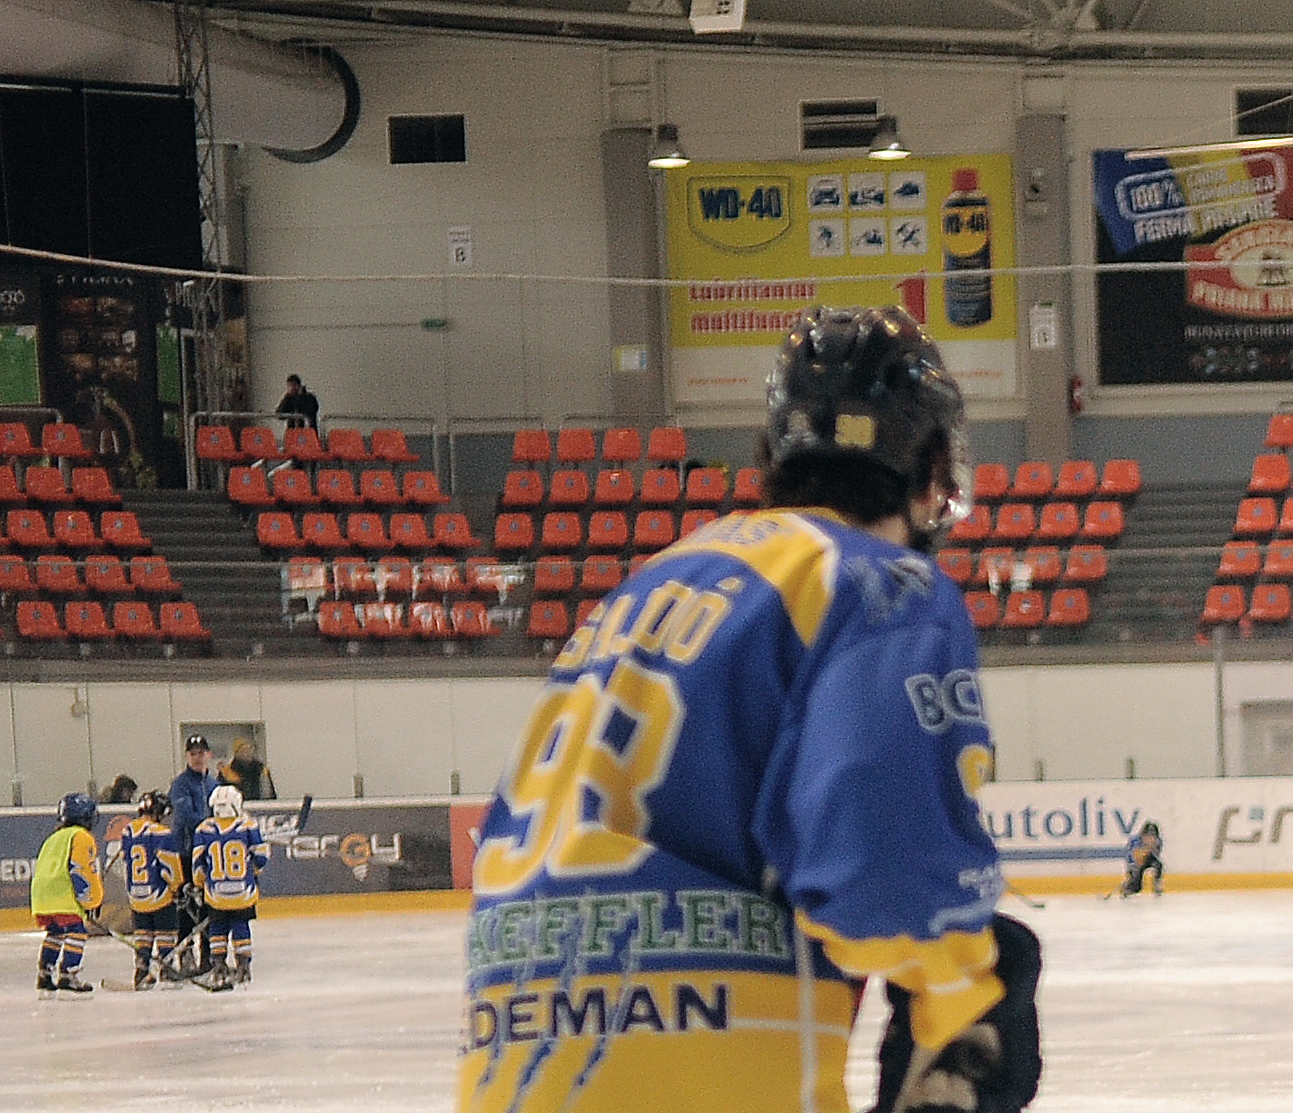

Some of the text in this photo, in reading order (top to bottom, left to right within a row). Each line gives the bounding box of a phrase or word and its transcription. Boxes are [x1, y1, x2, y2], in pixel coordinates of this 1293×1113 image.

[699, 185, 784, 220] WD-40
[905, 667, 985, 735] BC
[988, 797, 1142, 842] utoliv
[130, 844, 150, 883] 2
[206, 838, 248, 881] 18
